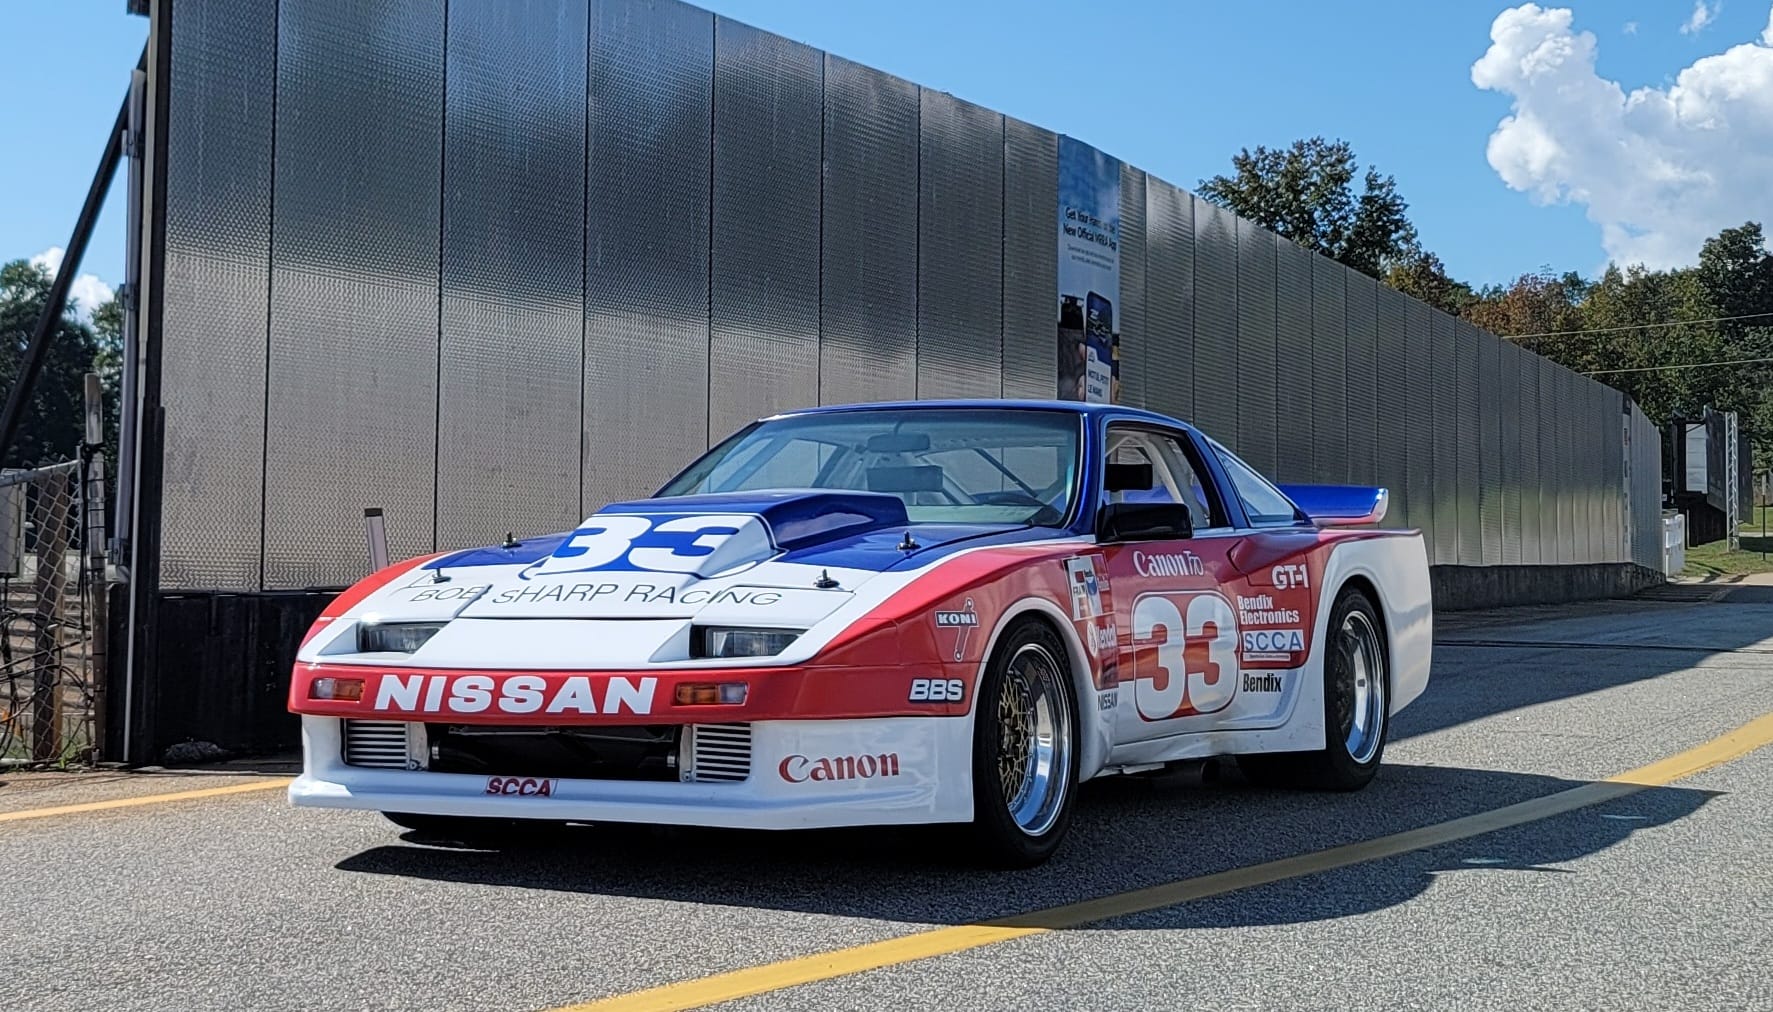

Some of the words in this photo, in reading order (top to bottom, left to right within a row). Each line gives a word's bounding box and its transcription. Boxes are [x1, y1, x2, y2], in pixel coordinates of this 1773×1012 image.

[528, 515, 758, 577] 33
[1133, 550, 1189, 577] Canon
[1272, 564, 1309, 590] GT-1
[492, 583, 619, 604] SHARP
[624, 584, 783, 606] RACING
[1237, 594, 1274, 610] Bendix
[938, 613, 977, 625] KONI
[1240, 608, 1300, 625] Electronics
[1244, 631, 1303, 651] SCCA
[1133, 594, 1239, 720] 33
[909, 678, 964, 701] BBS
[1243, 672, 1282, 693] Bendix
[374, 674, 658, 715] NISSAN
[778, 753, 900, 784] Canon
[486, 777, 551, 797] SCCA
